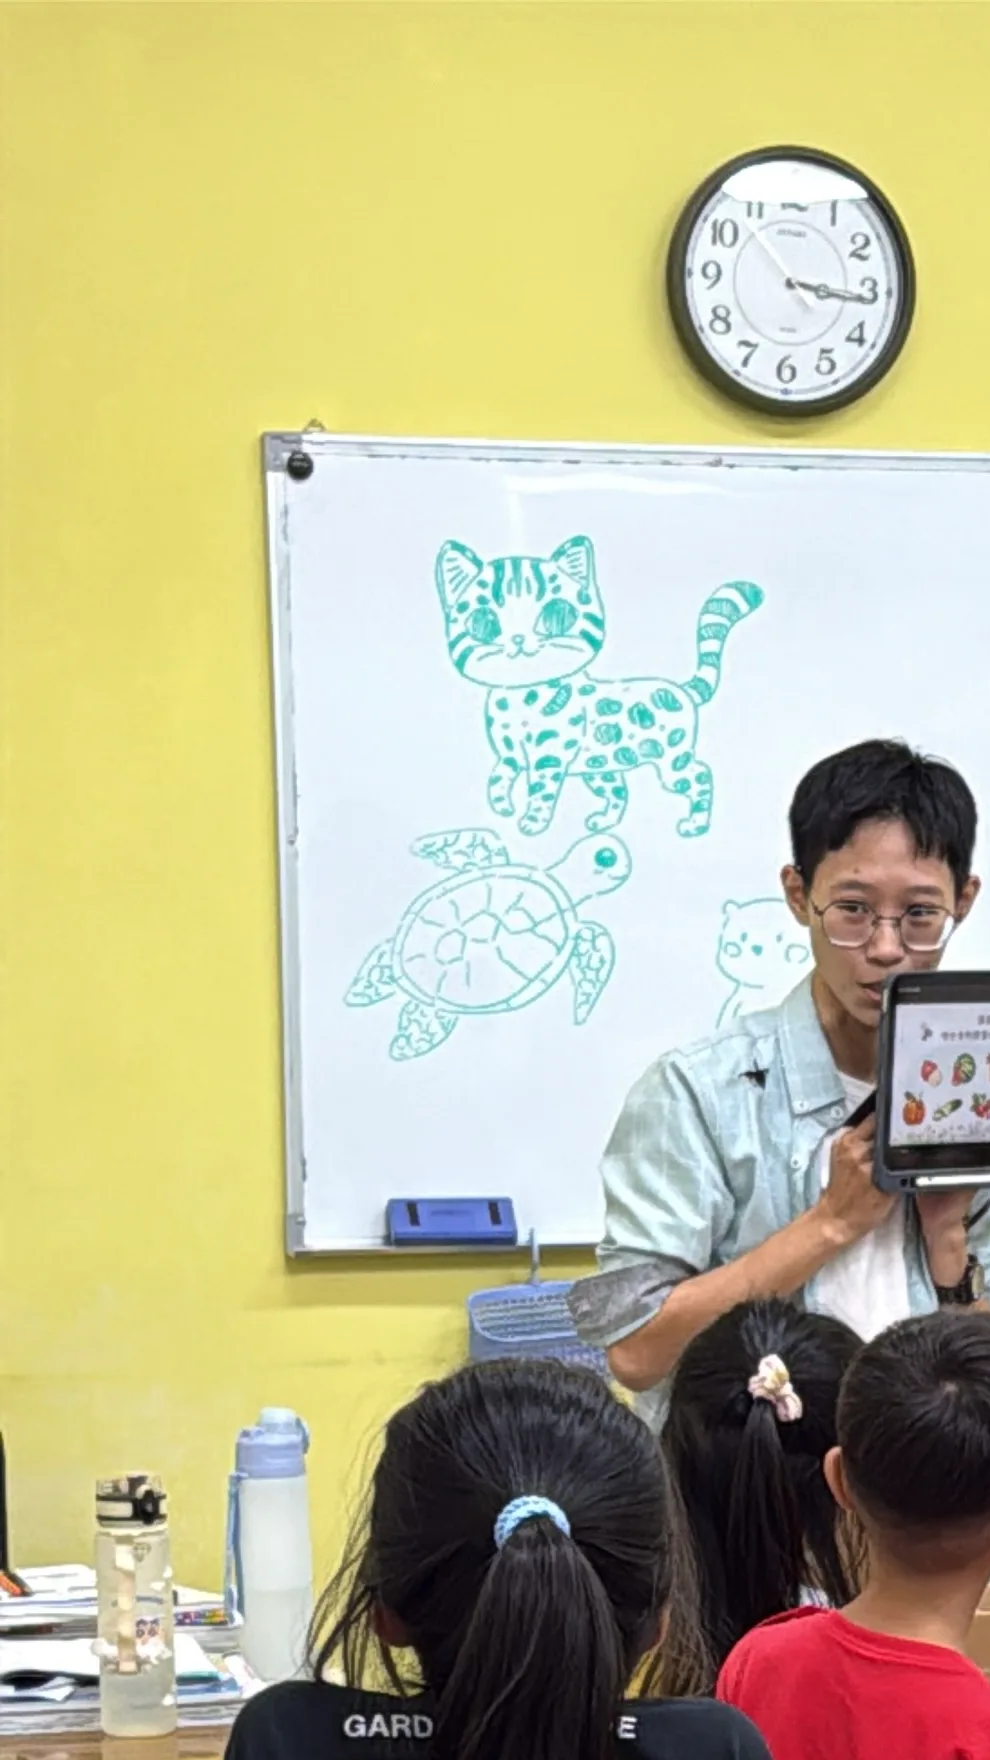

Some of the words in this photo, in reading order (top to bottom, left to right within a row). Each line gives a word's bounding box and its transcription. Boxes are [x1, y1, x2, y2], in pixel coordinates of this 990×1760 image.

[711, 219, 739, 248] 10
[849, 232, 871, 262] 2
[701, 260, 722, 290] 9
[859, 276, 878, 305] 3
[709, 304, 732, 335] 8
[845, 320, 867, 348] 4
[737, 339, 759, 368] 7
[815, 347, 837, 376] 5
[776, 354, 797, 384] 6
[343, 1713, 434, 1739] GARD
